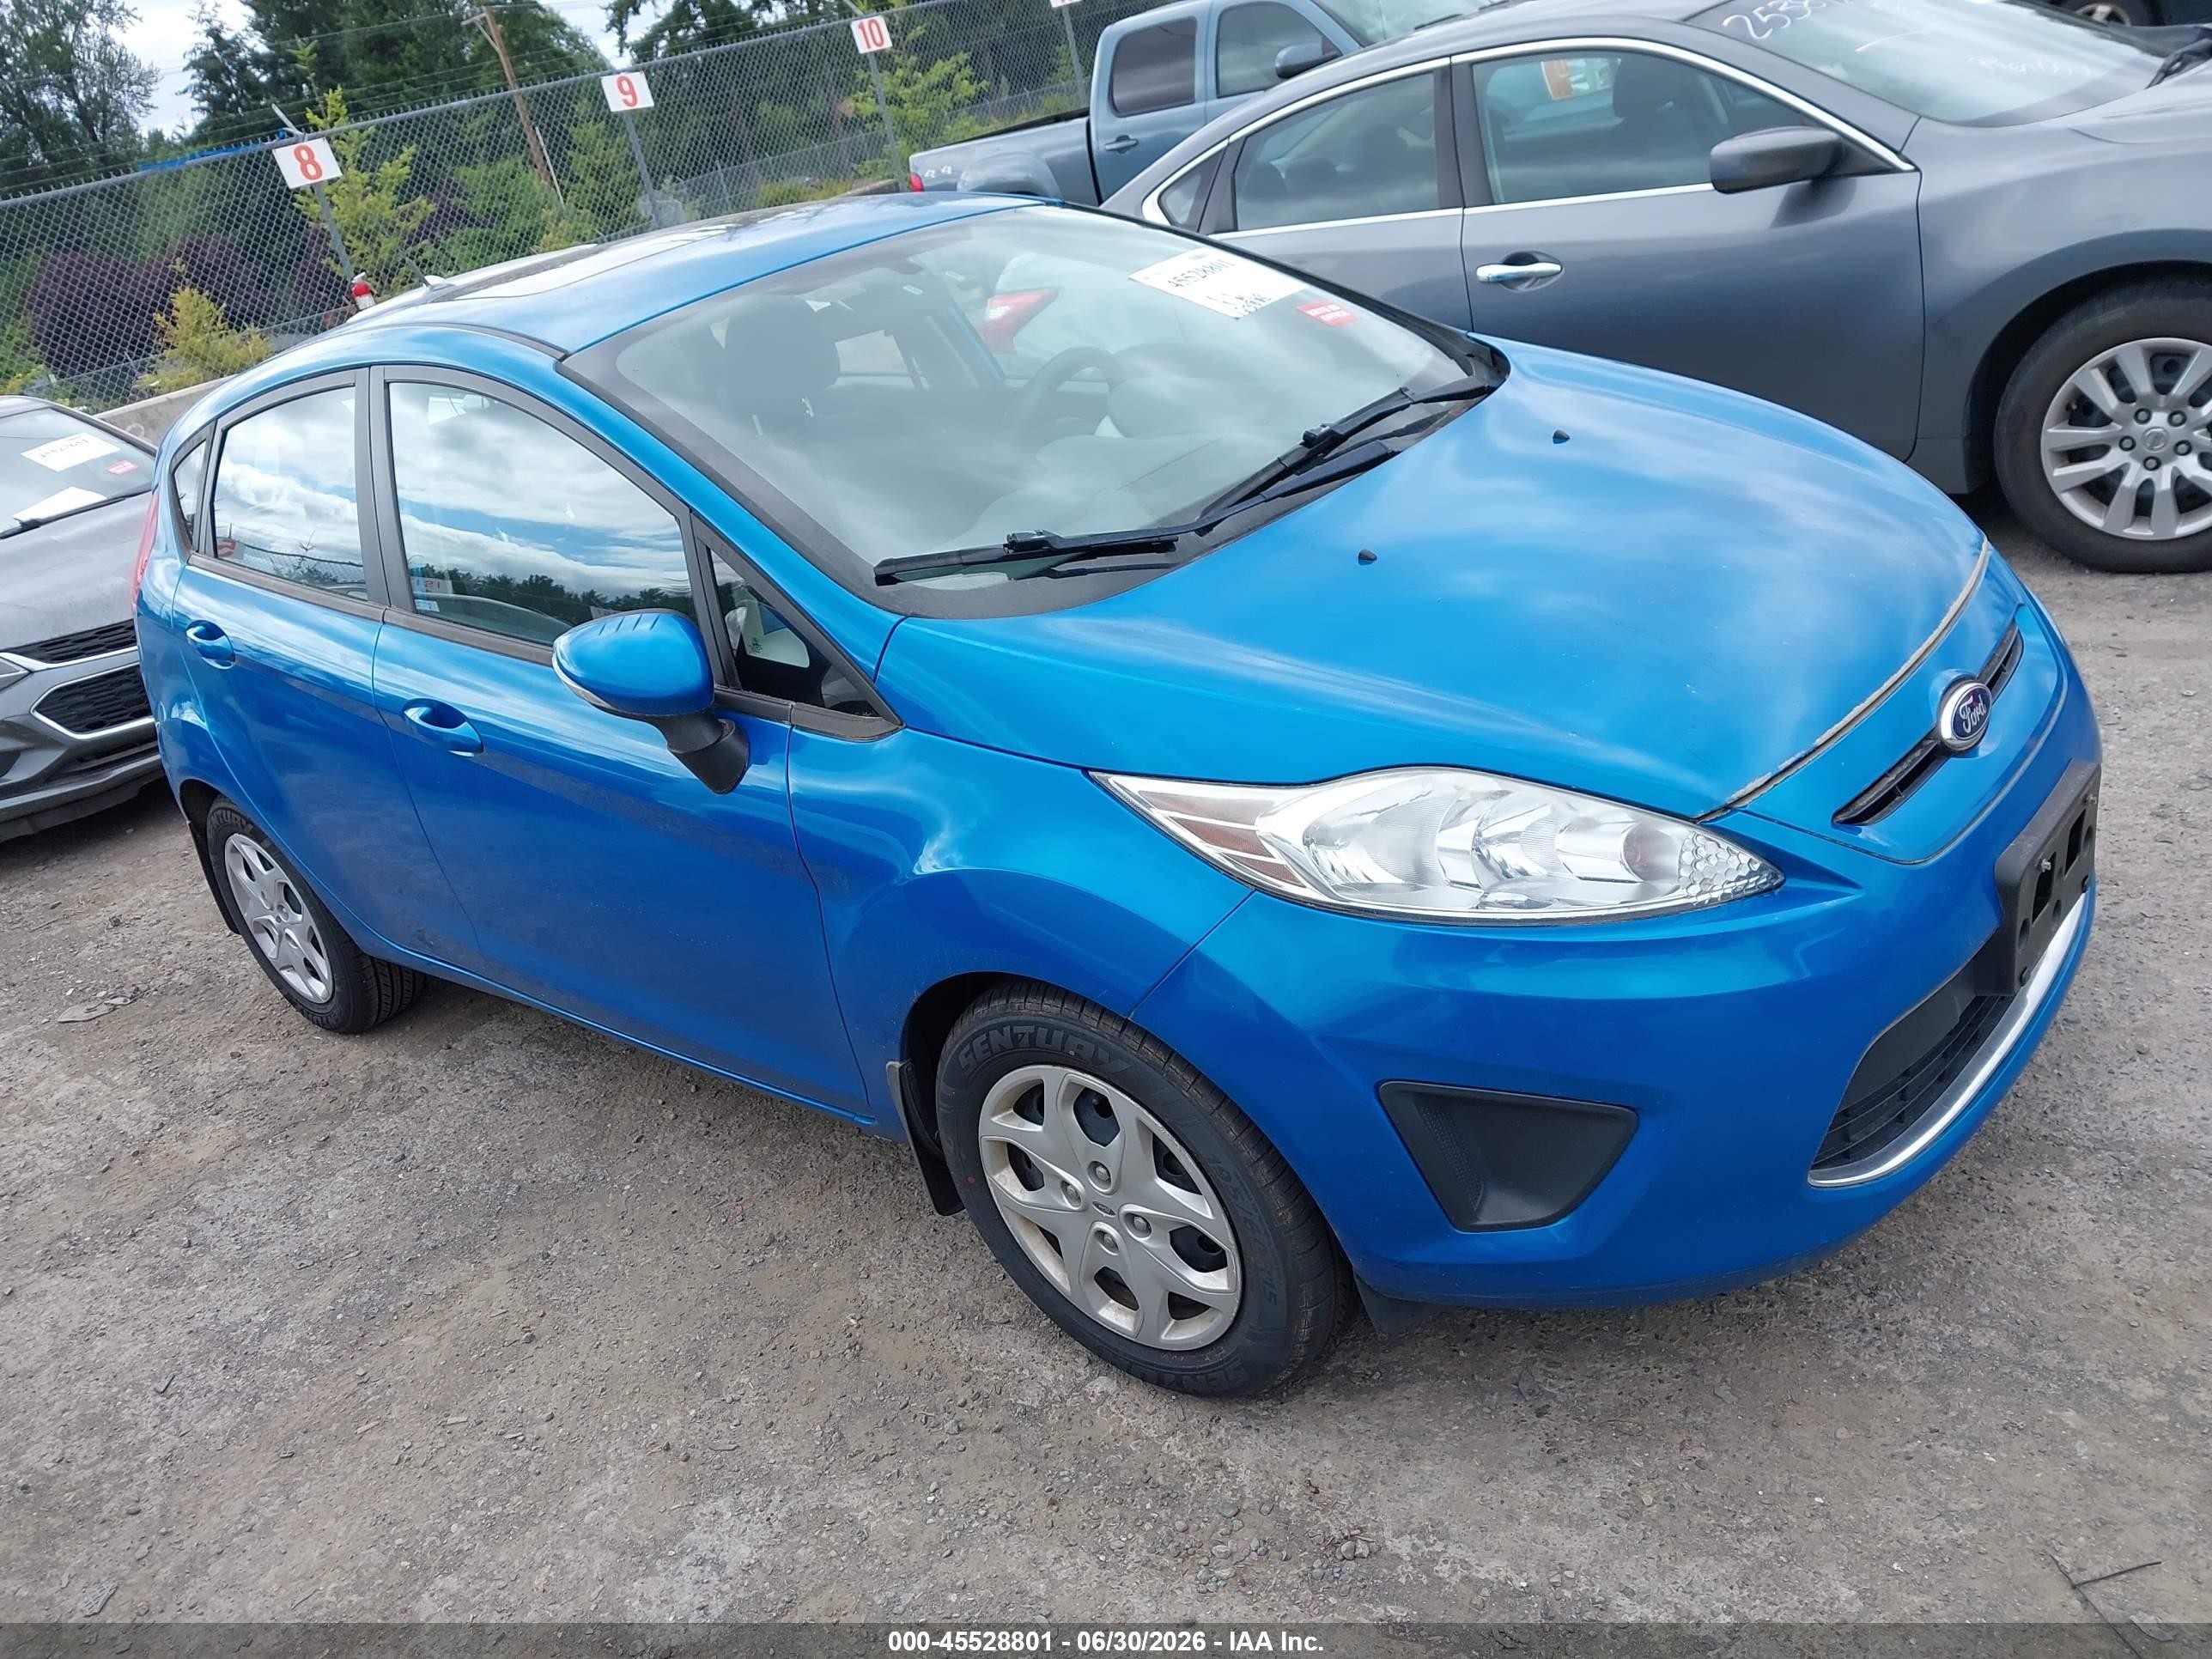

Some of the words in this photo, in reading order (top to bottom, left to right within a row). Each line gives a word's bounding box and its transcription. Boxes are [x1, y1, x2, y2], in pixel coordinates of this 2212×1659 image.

[858, 18, 884, 49] 10
[617, 76, 638, 107] 9
[294, 144, 323, 180] 8
[1959, 693, 1987, 734] Ford
